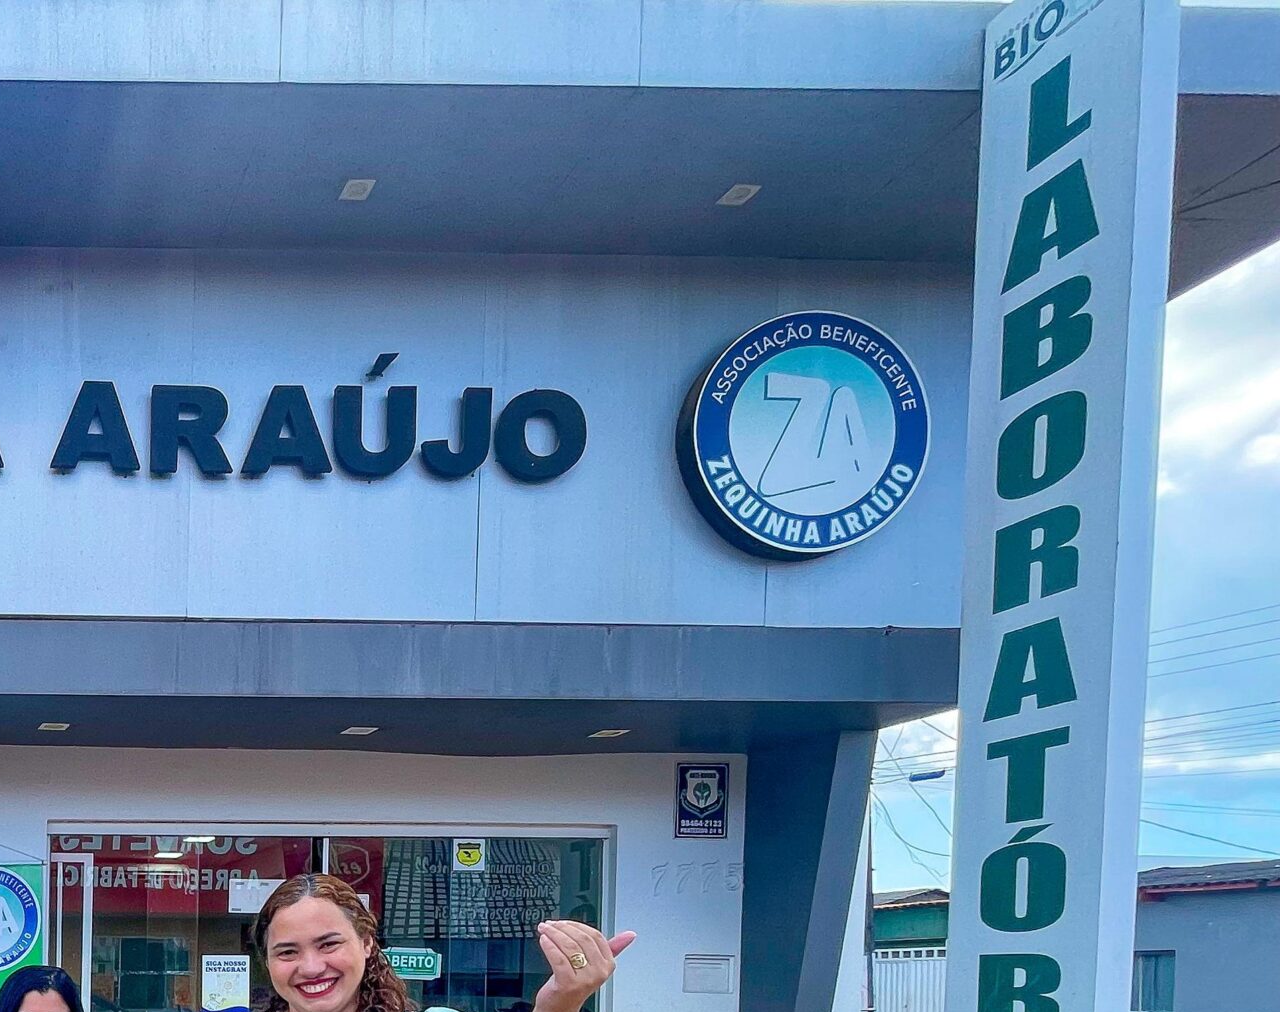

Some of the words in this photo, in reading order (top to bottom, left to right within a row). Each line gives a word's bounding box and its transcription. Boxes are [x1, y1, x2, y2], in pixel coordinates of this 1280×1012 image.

[993, 0, 1065, 80] BIO
[711, 322, 813, 404] ASSOCIAÇÃO
[820, 324, 917, 411] BENEFICENTE
[50, 352, 588, 483] ARAÚJO
[757, 372, 869, 498] ZA
[706, 454, 821, 544] ZEQUINHA
[828, 463, 914, 543] ARAÚJO
